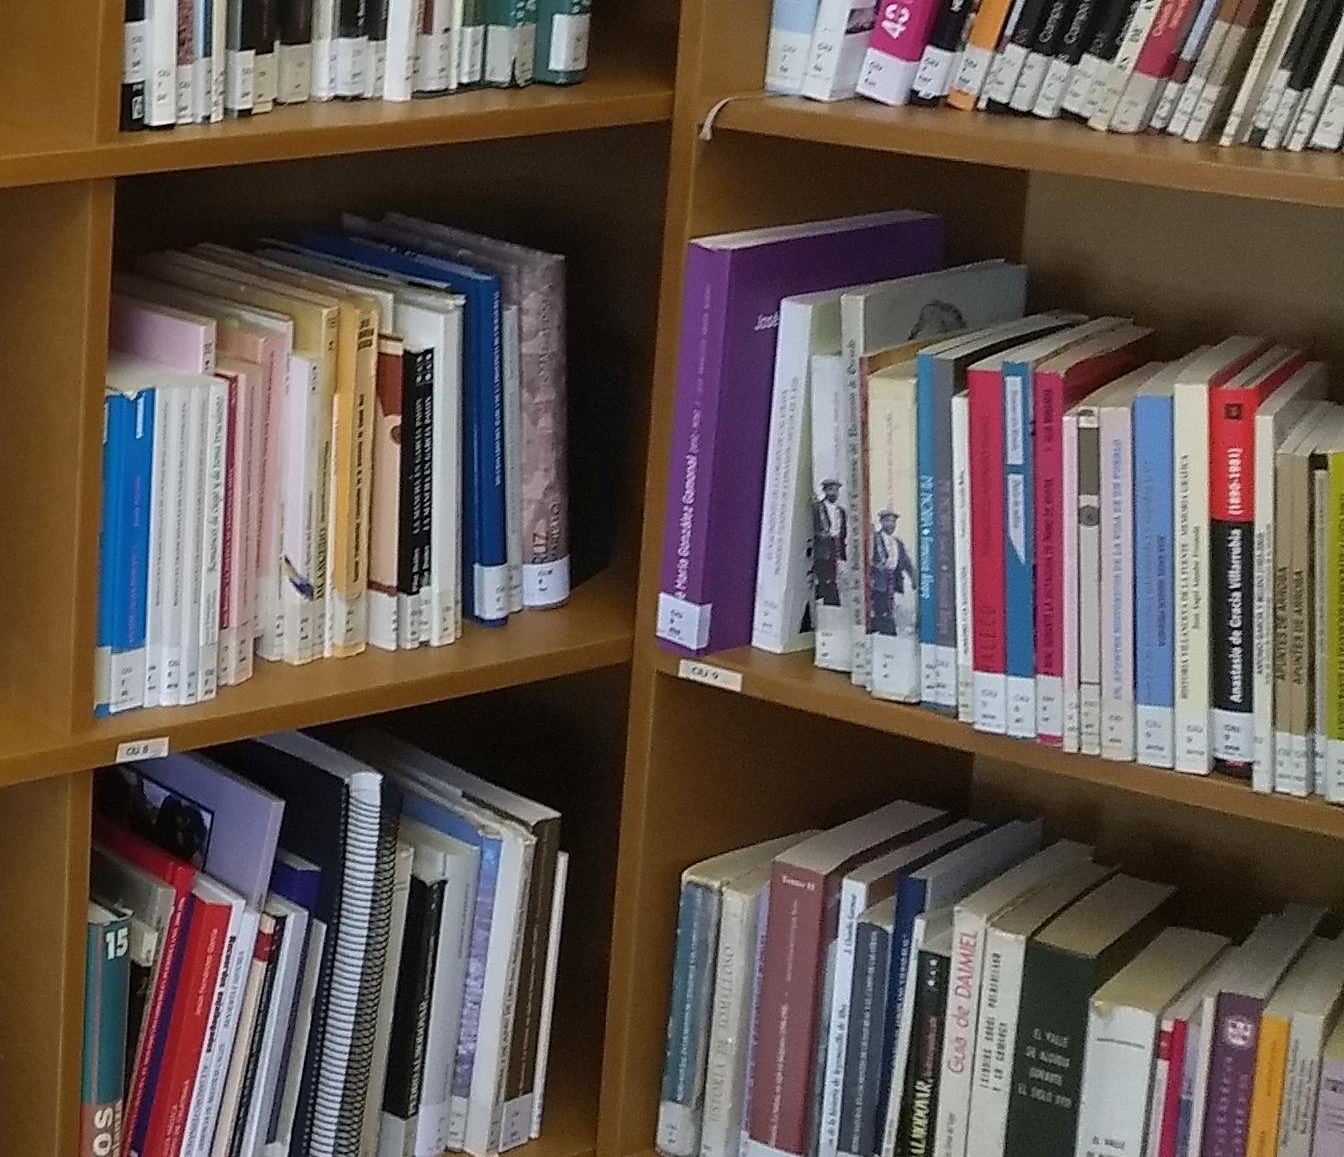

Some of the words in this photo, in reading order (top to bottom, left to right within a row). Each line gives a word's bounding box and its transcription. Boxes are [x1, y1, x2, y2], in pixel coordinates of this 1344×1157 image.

[1229, 629, 1241, 644] de
[1229, 646, 1241, 702] Anastasio
[953, 929, 978, 999] DAIMIEL
[950, 1004, 970, 1027] de
